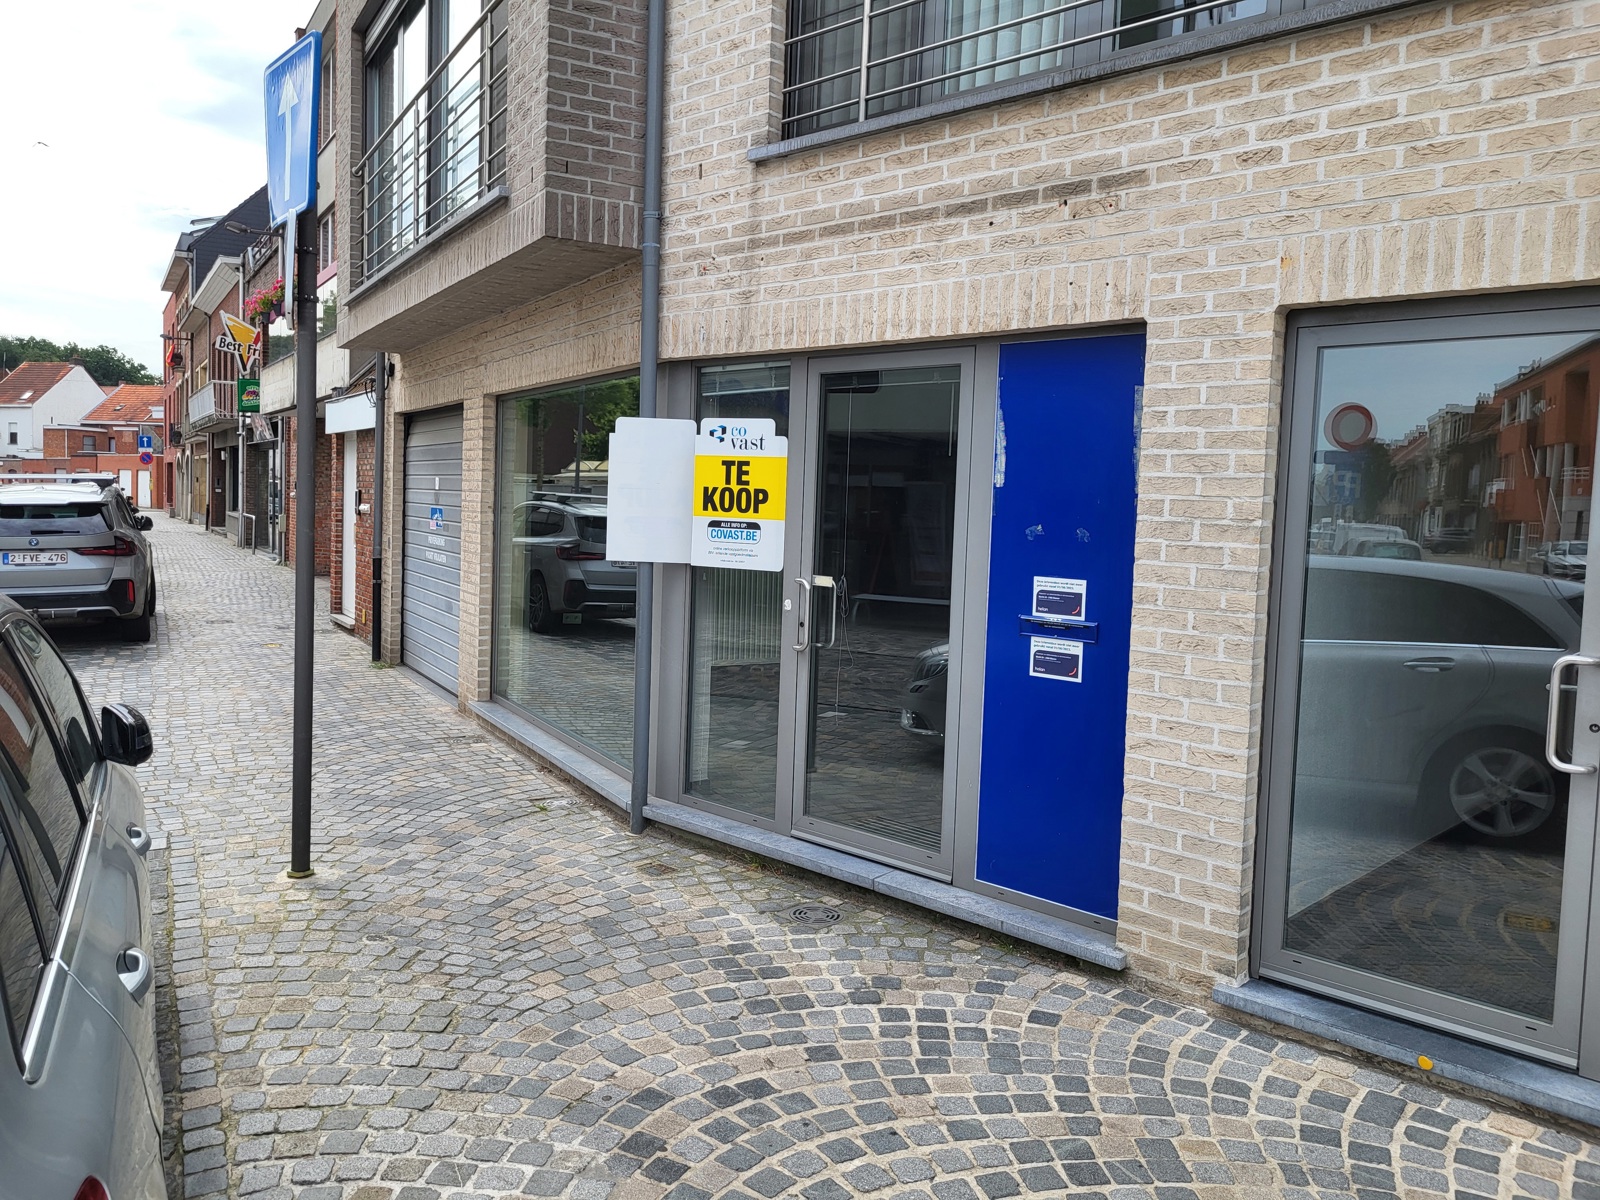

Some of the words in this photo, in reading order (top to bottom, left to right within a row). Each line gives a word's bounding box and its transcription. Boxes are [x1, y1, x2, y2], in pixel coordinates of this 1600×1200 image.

[219, 337, 243, 353] Best
[731, 426, 747, 437] co
[731, 434, 766, 451] vast
[721, 460, 750, 486] TE
[702, 486, 769, 514] KOOP
[710, 528, 758, 541] COVAST.BE
